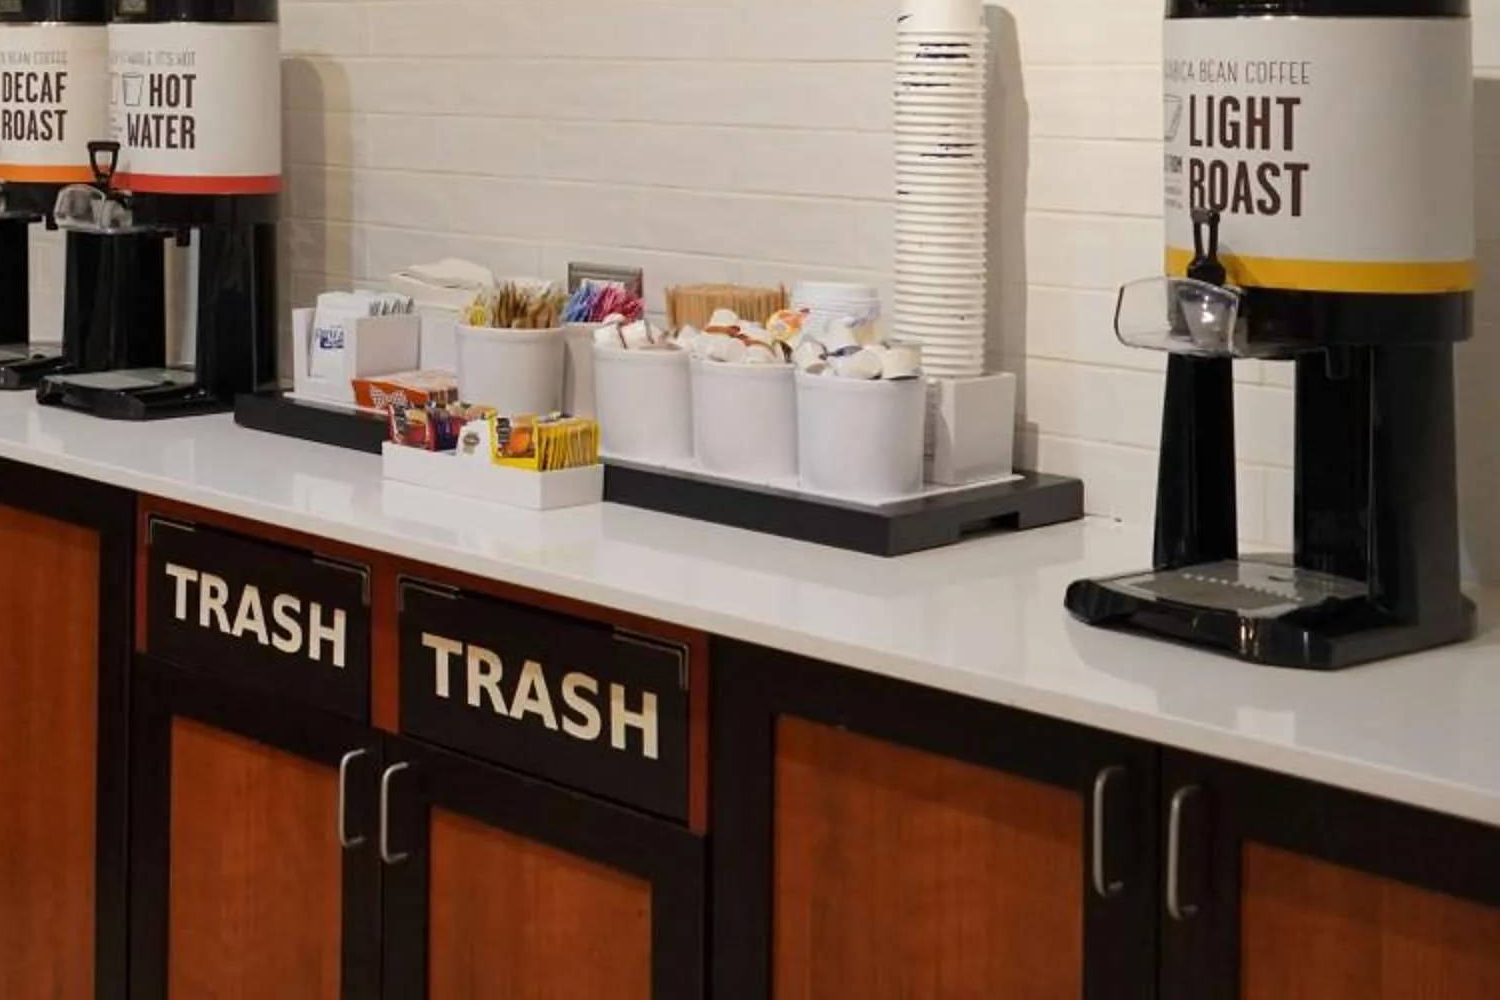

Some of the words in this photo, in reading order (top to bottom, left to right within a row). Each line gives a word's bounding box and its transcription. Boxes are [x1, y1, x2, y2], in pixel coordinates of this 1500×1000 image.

[2, 71, 68, 103] DECAF
[149, 73, 197, 108] HOT
[1199, 60, 1238, 83] BEAN
[1245, 61, 1312, 85] COFFEE
[2, 109, 68, 141] ROAST
[127, 112, 196, 150] WATER
[1189, 94, 1302, 151] LIGHT
[1189, 157, 1310, 217] ROAST
[165, 562, 347, 668] TRASH
[421, 631, 659, 760] TRASH
